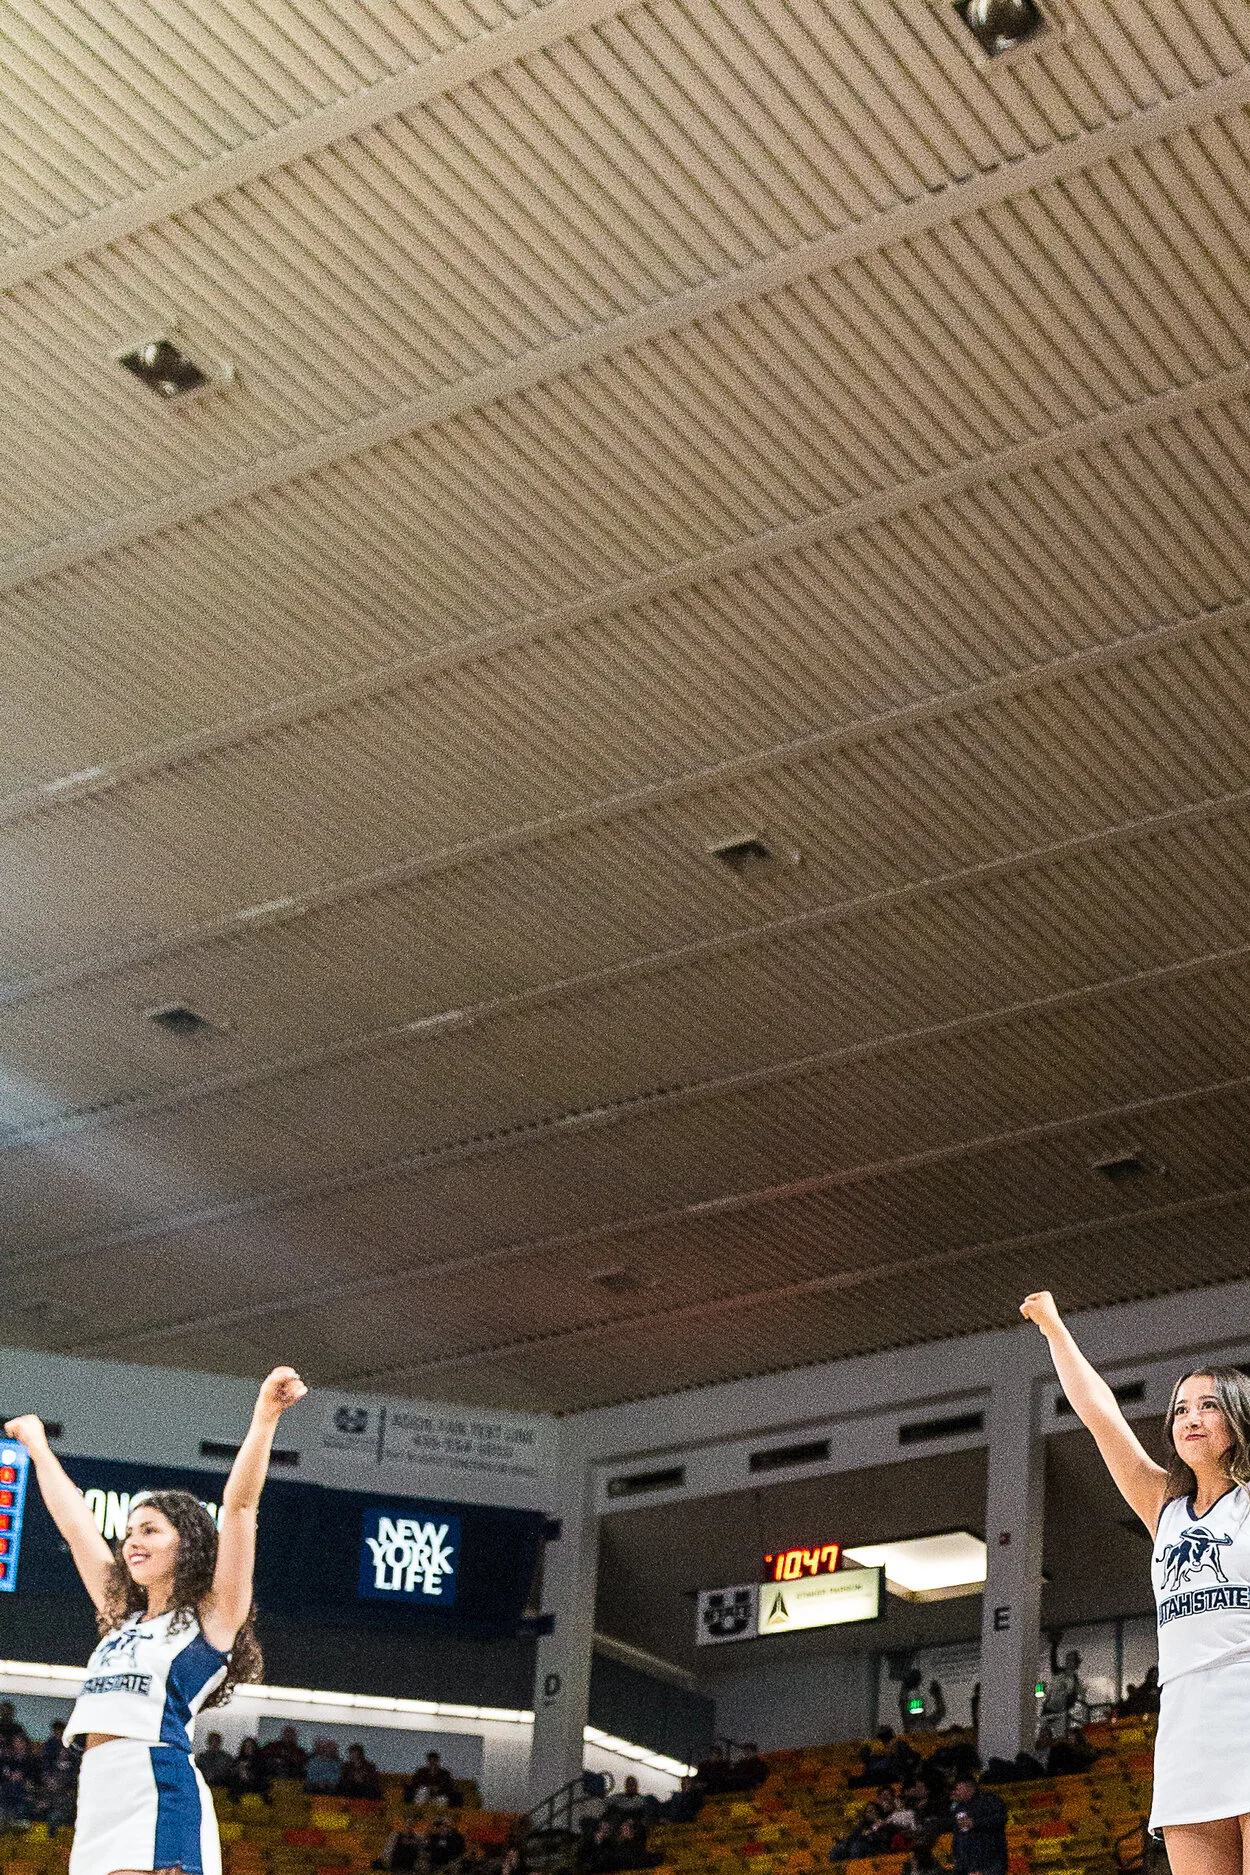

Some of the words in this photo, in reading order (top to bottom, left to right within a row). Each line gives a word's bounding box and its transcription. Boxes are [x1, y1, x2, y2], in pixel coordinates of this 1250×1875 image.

[378, 1516, 449, 1549] NEW
[365, 1537, 454, 1575] YORK
[374, 1562, 443, 1596] LIFE
[1191, 1584, 1250, 1615] STATE
[994, 1606, 1011, 1632] E
